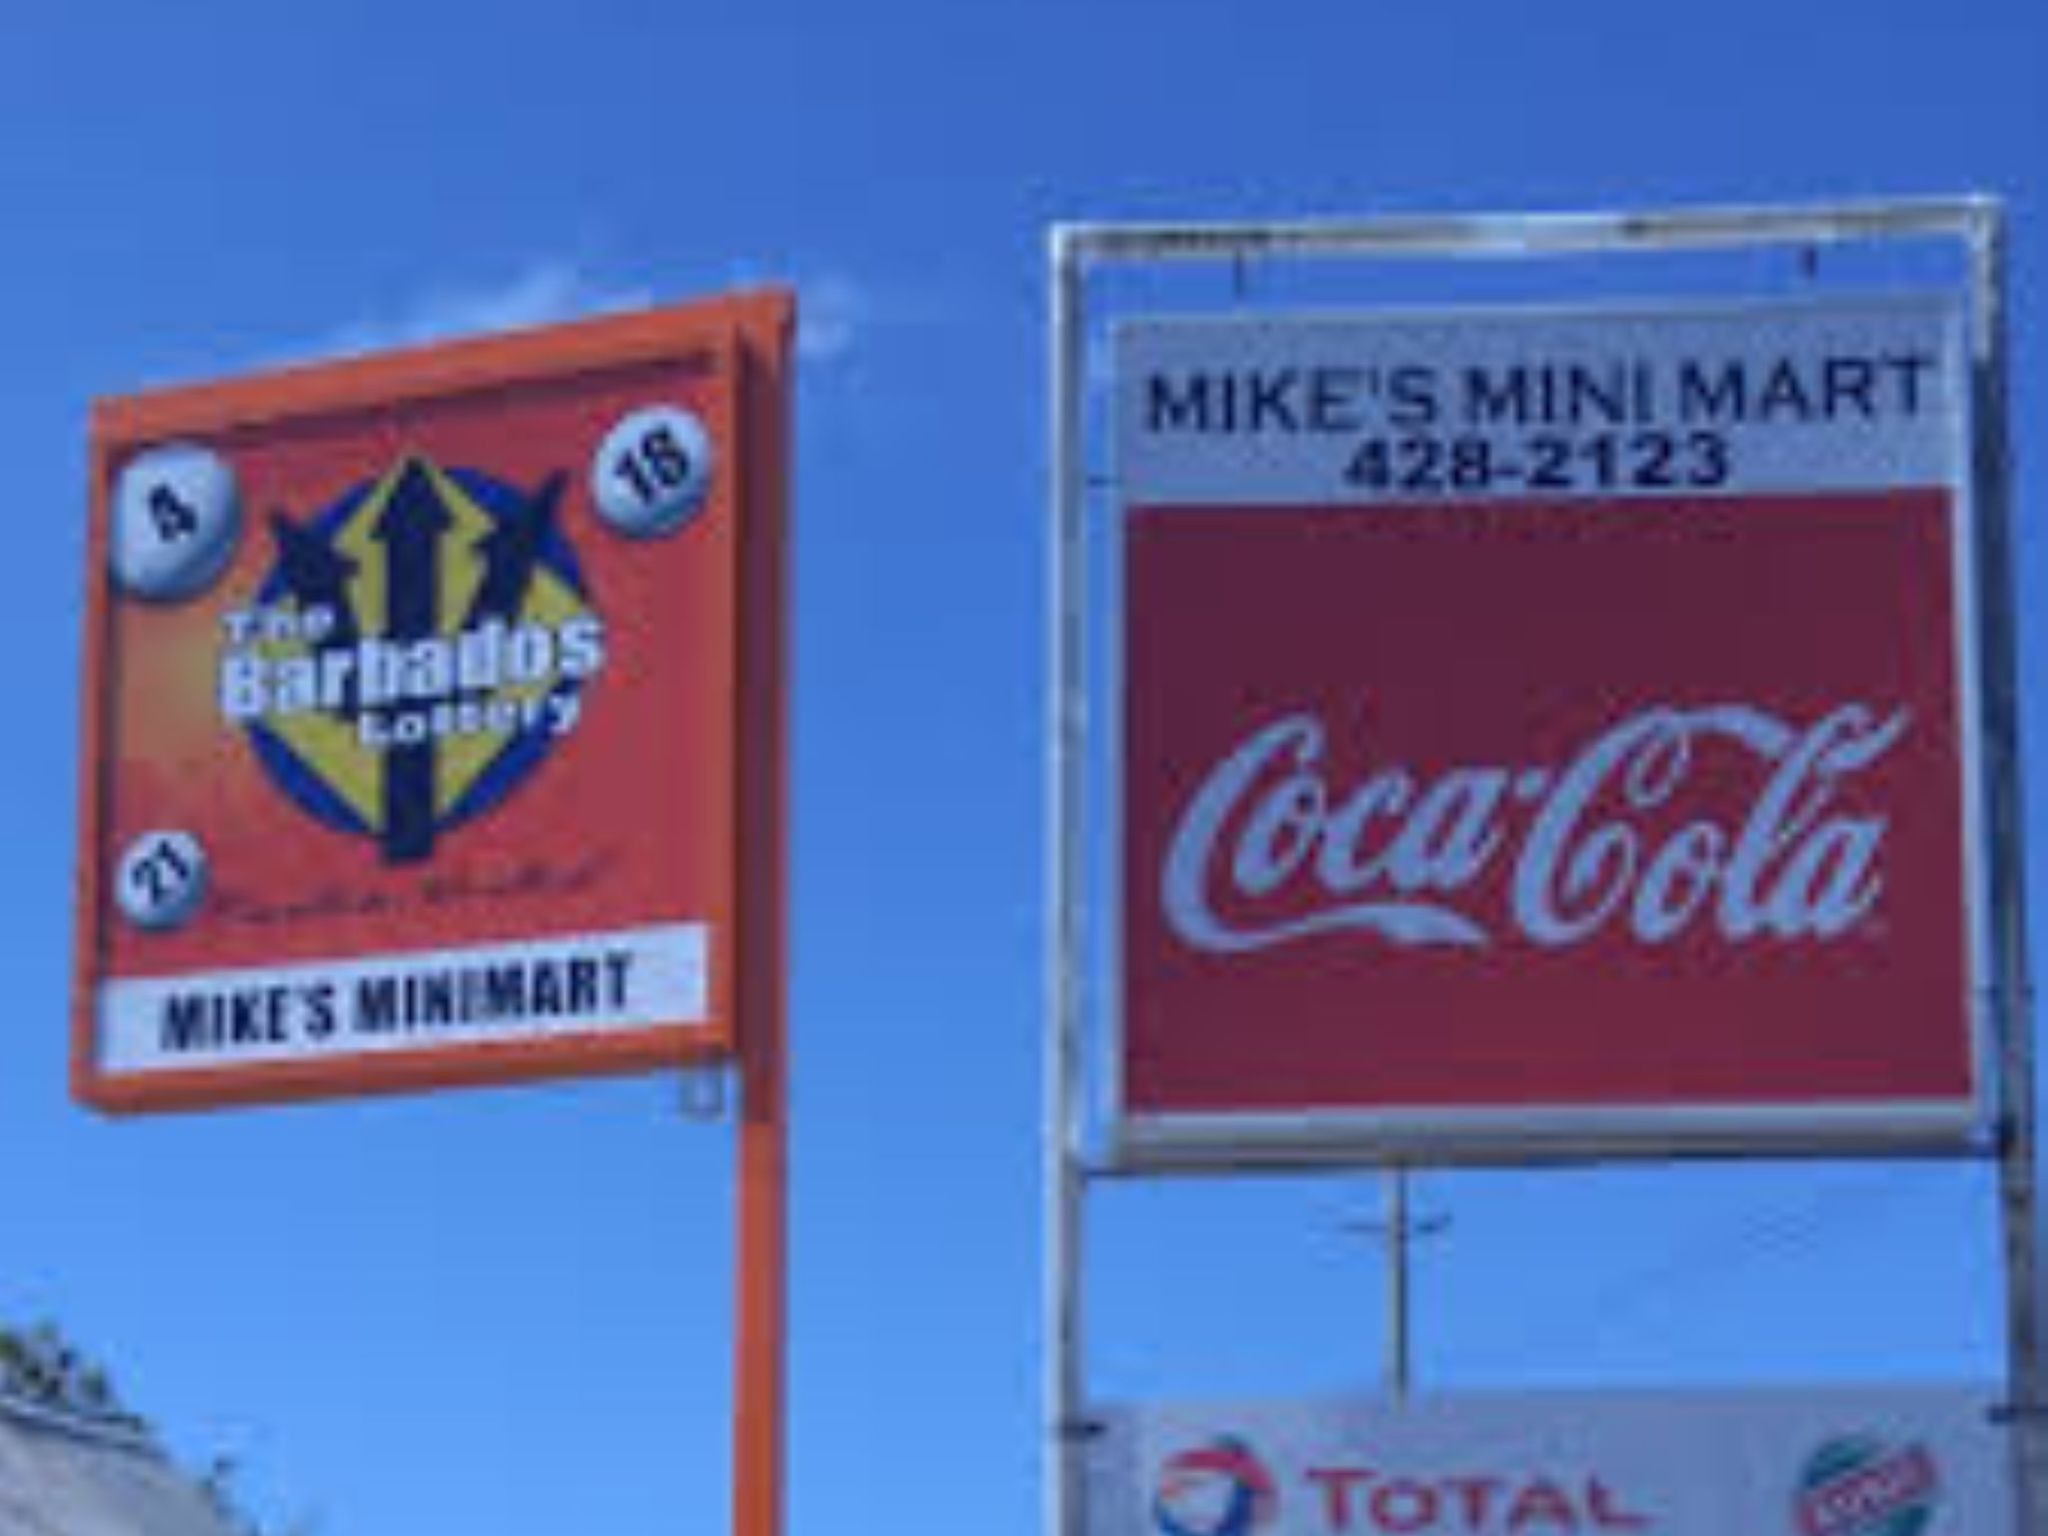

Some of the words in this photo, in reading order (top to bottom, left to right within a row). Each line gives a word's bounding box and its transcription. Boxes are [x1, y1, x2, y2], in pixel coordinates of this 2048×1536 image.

[1145, 365, 1437, 436] MIKE'S
[1459, 359, 1653, 428] MINI
[1676, 355, 1933, 422] MART
[1344, 431, 1730, 491] 428-2123
[147, 482, 199, 542] 4
[220, 606, 336, 644] The
[219, 614, 606, 722] Barbados
[358, 692, 584, 746] Lottery
[1160, 704, 1912, 952] Coca-Cola
[130, 838, 189, 908] 21
[159, 982, 338, 1052] MIKE'S
[351, 949, 634, 1034] MINIMART
[1304, 1465, 1662, 1536] TOTAL
